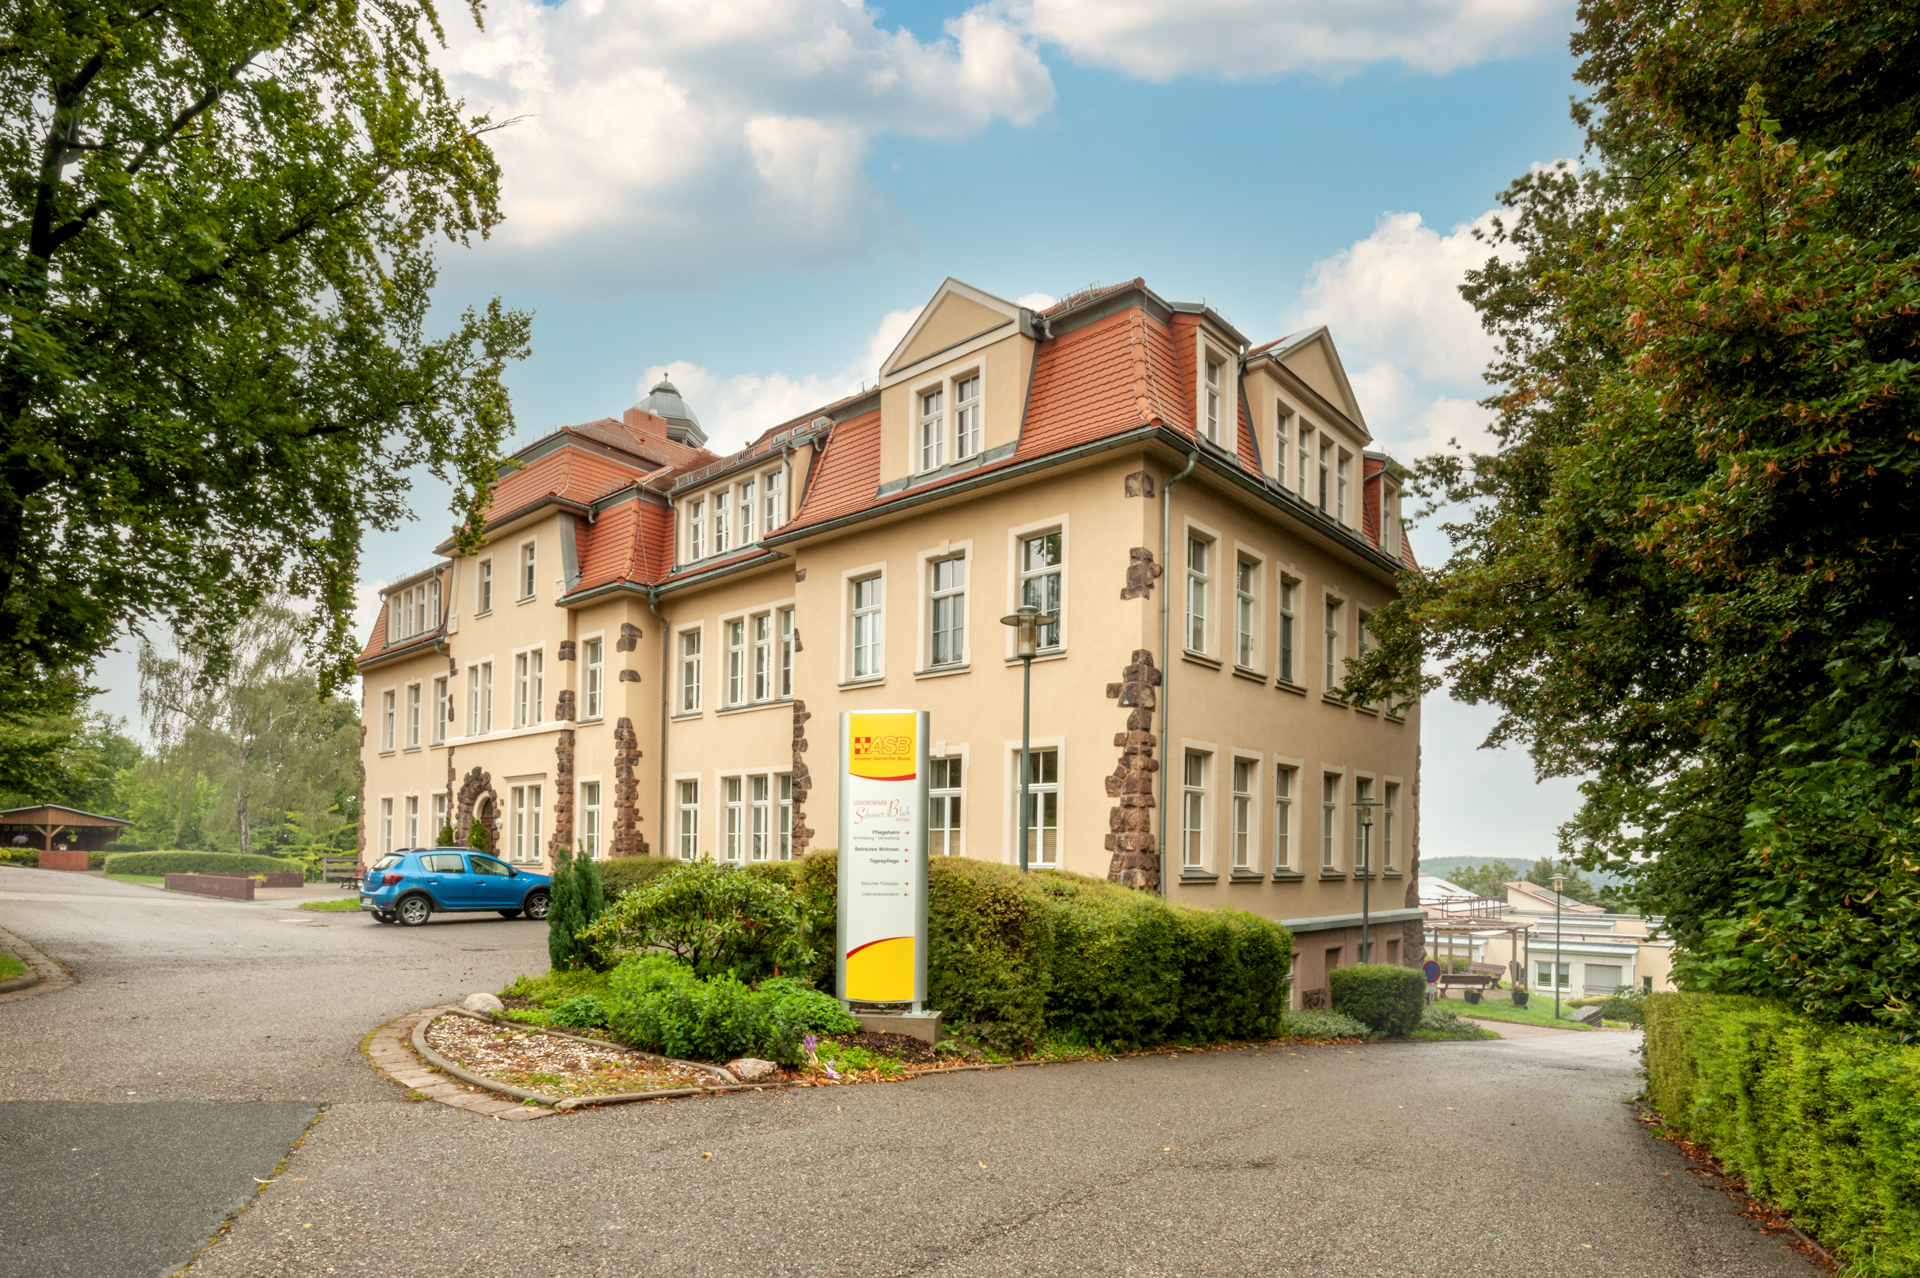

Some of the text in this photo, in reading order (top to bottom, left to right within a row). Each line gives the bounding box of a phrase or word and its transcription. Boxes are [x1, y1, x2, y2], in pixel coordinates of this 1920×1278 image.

[867, 735, 912, 755] ASB
[854, 799, 910, 824] Schöner Blick
